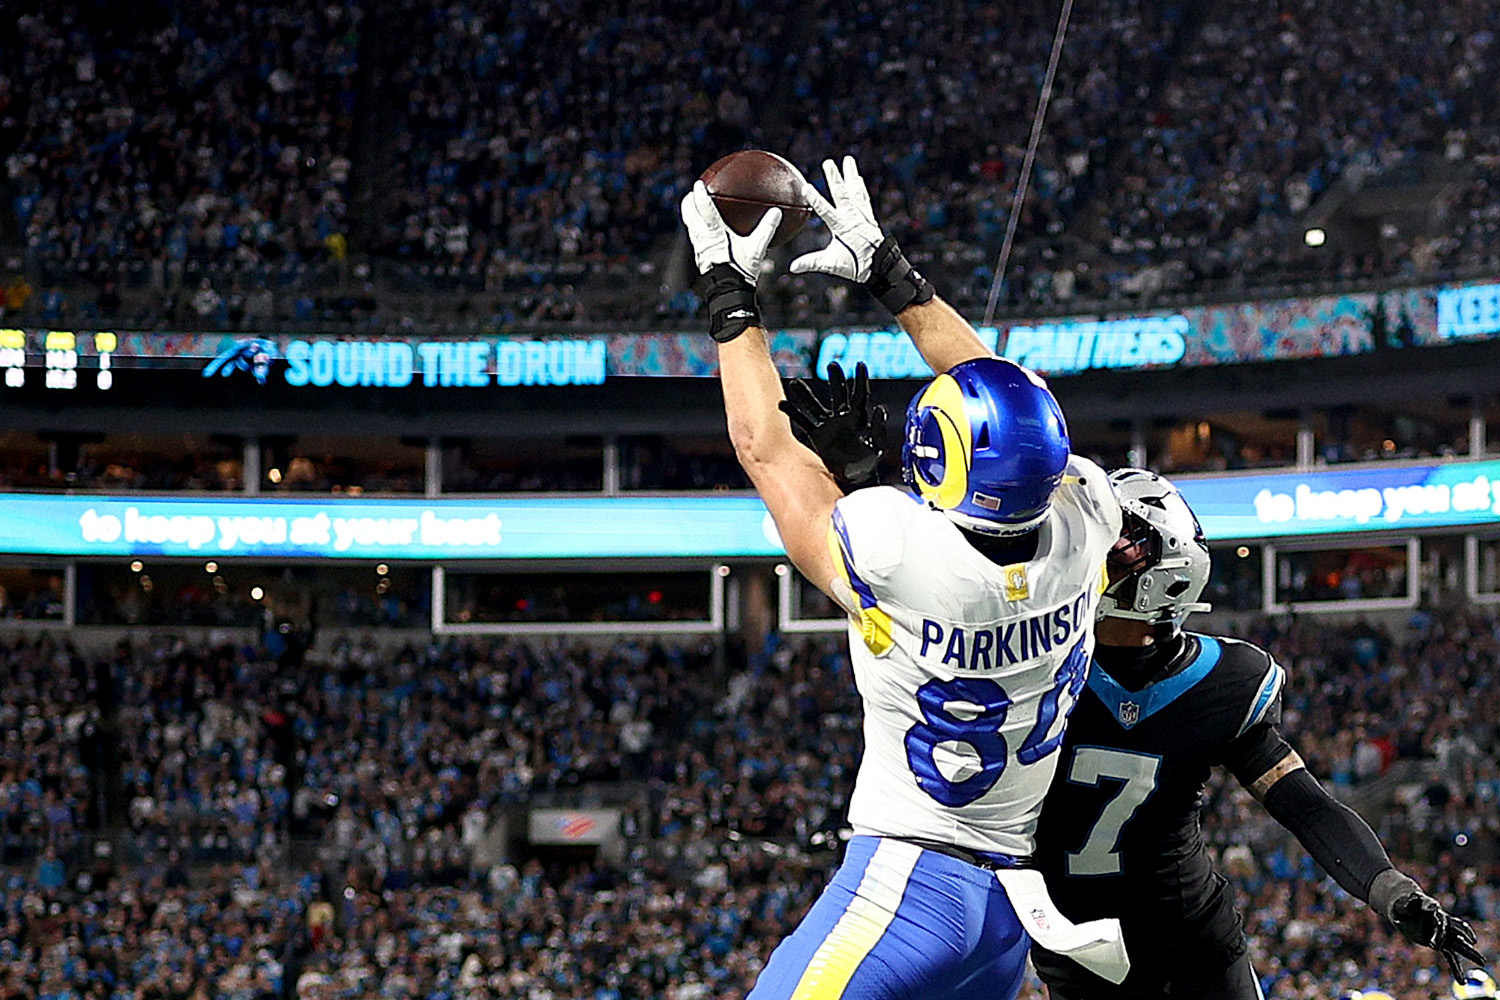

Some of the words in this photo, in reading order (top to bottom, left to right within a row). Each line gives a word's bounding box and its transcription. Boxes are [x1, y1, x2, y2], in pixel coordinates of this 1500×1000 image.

[284, 340, 413, 387] SOUND
[417, 341, 491, 387] THE
[496, 340, 606, 387] DRUM
[1003, 314, 1189, 371] PANTHERS
[1254, 489, 1295, 522] to
[1296, 484, 1382, 524] keep
[1383, 485, 1450, 522] you
[1452, 475, 1491, 511] at
[80, 508, 121, 542] to
[125, 507, 215, 549] keep
[218, 516, 287, 549] you
[289, 512, 331, 545] at
[333, 517, 418, 551] your
[420, 510, 501, 547] best
[904, 632, 1089, 808] 84
[1065, 743, 1163, 878] 7
